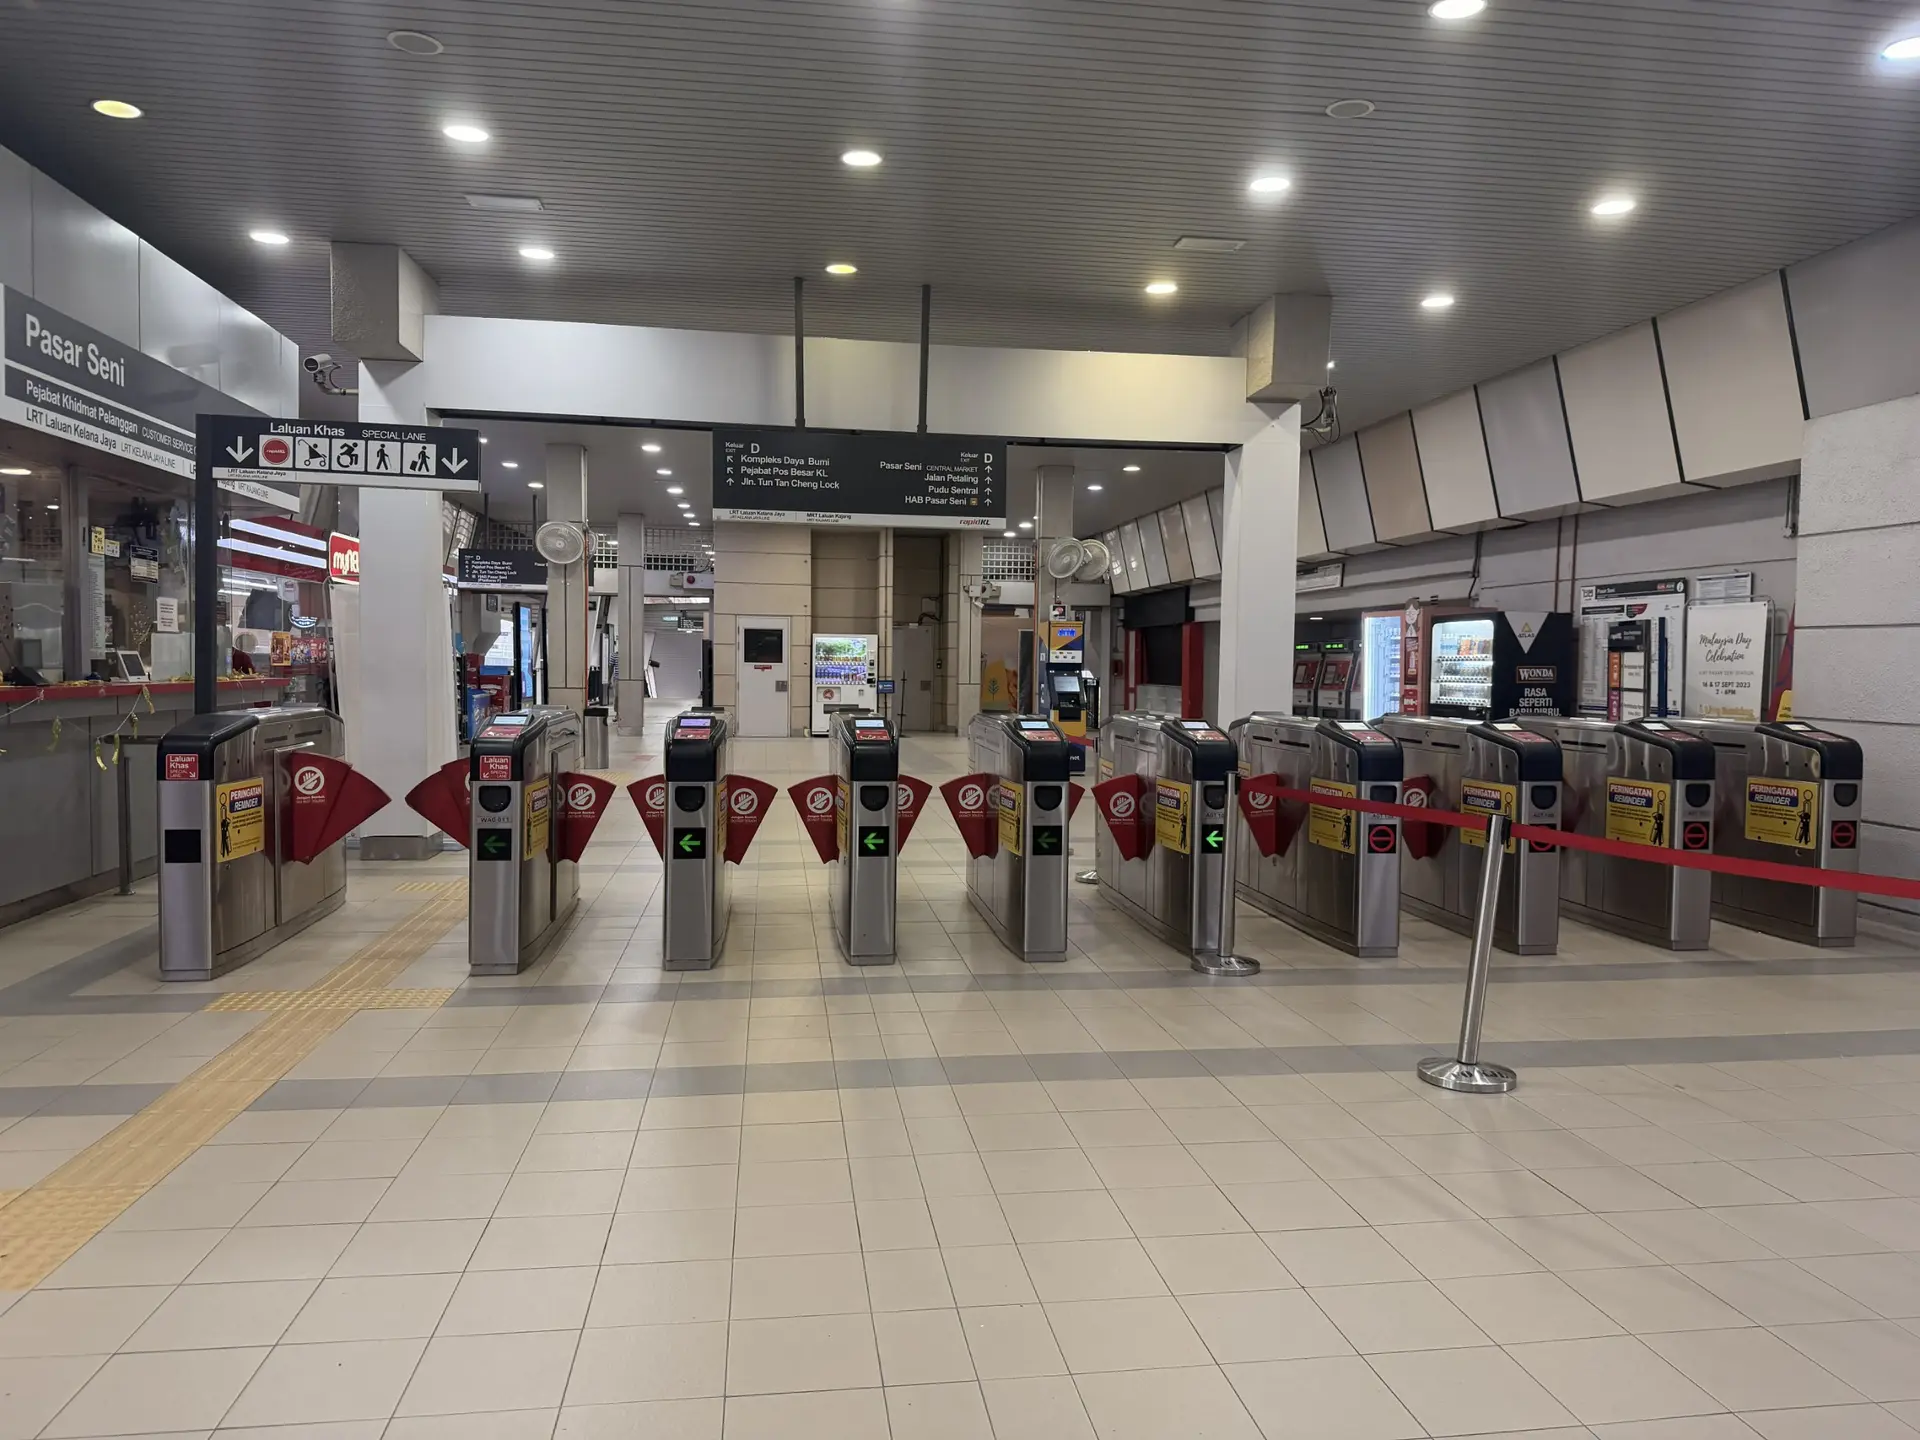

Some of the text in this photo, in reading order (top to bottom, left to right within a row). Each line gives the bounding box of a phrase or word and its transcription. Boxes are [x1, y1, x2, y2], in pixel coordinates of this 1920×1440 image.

[26, 313, 124, 387] Pasar Seni
[26, 380, 194, 454] Pejabat Khidmat Pelanggan CUSTOMER SERVICE
[26, 406, 116, 450] LRT Laluan Kelana Jaya
[270, 422, 426, 442] Laluan Khas SPECIAL LANE
[751, 443, 760, 454] D
[121, 441, 132, 454] LRT
[165, 457, 176, 469] LINE
[740, 455, 830, 466] Kompleks Daya Bumi
[984, 453, 992, 463] D
[740, 466, 771, 476] Pejabat
[773, 467, 789, 476] Pos
[790, 468, 814, 476] Besar
[880, 461, 903, 470] Pasar
[758, 478, 773, 486] Tun
[774, 478, 789, 487] Tan
[791, 479, 818, 490] Cheng
[819, 481, 840, 489] Lock
[924, 474, 979, 484] Jalan Petaling
[950, 486, 978, 495] Sentral
[905, 496, 924, 504] HAB
[1699, 632, 1752, 649] Malaysia Day
[1706, 649, 1745, 662] Celebration
[1519, 669, 1553, 680] WONDA
[1524, 688, 1547, 697] RASA
[1519, 698, 1552, 707] SEPERTI
[230, 786, 262, 800] PERINGATAN
[1464, 785, 1500, 798] PERINGATAN
[1610, 784, 1652, 798] PERINGATAN
[1750, 784, 1797, 797] PERINGATAN
[234, 798, 258, 811] REMINDER
[1467, 796, 1494, 808] REMINDER
[1614, 794, 1646, 806] REMINDER
[1755, 794, 1790, 805] REMINDER
